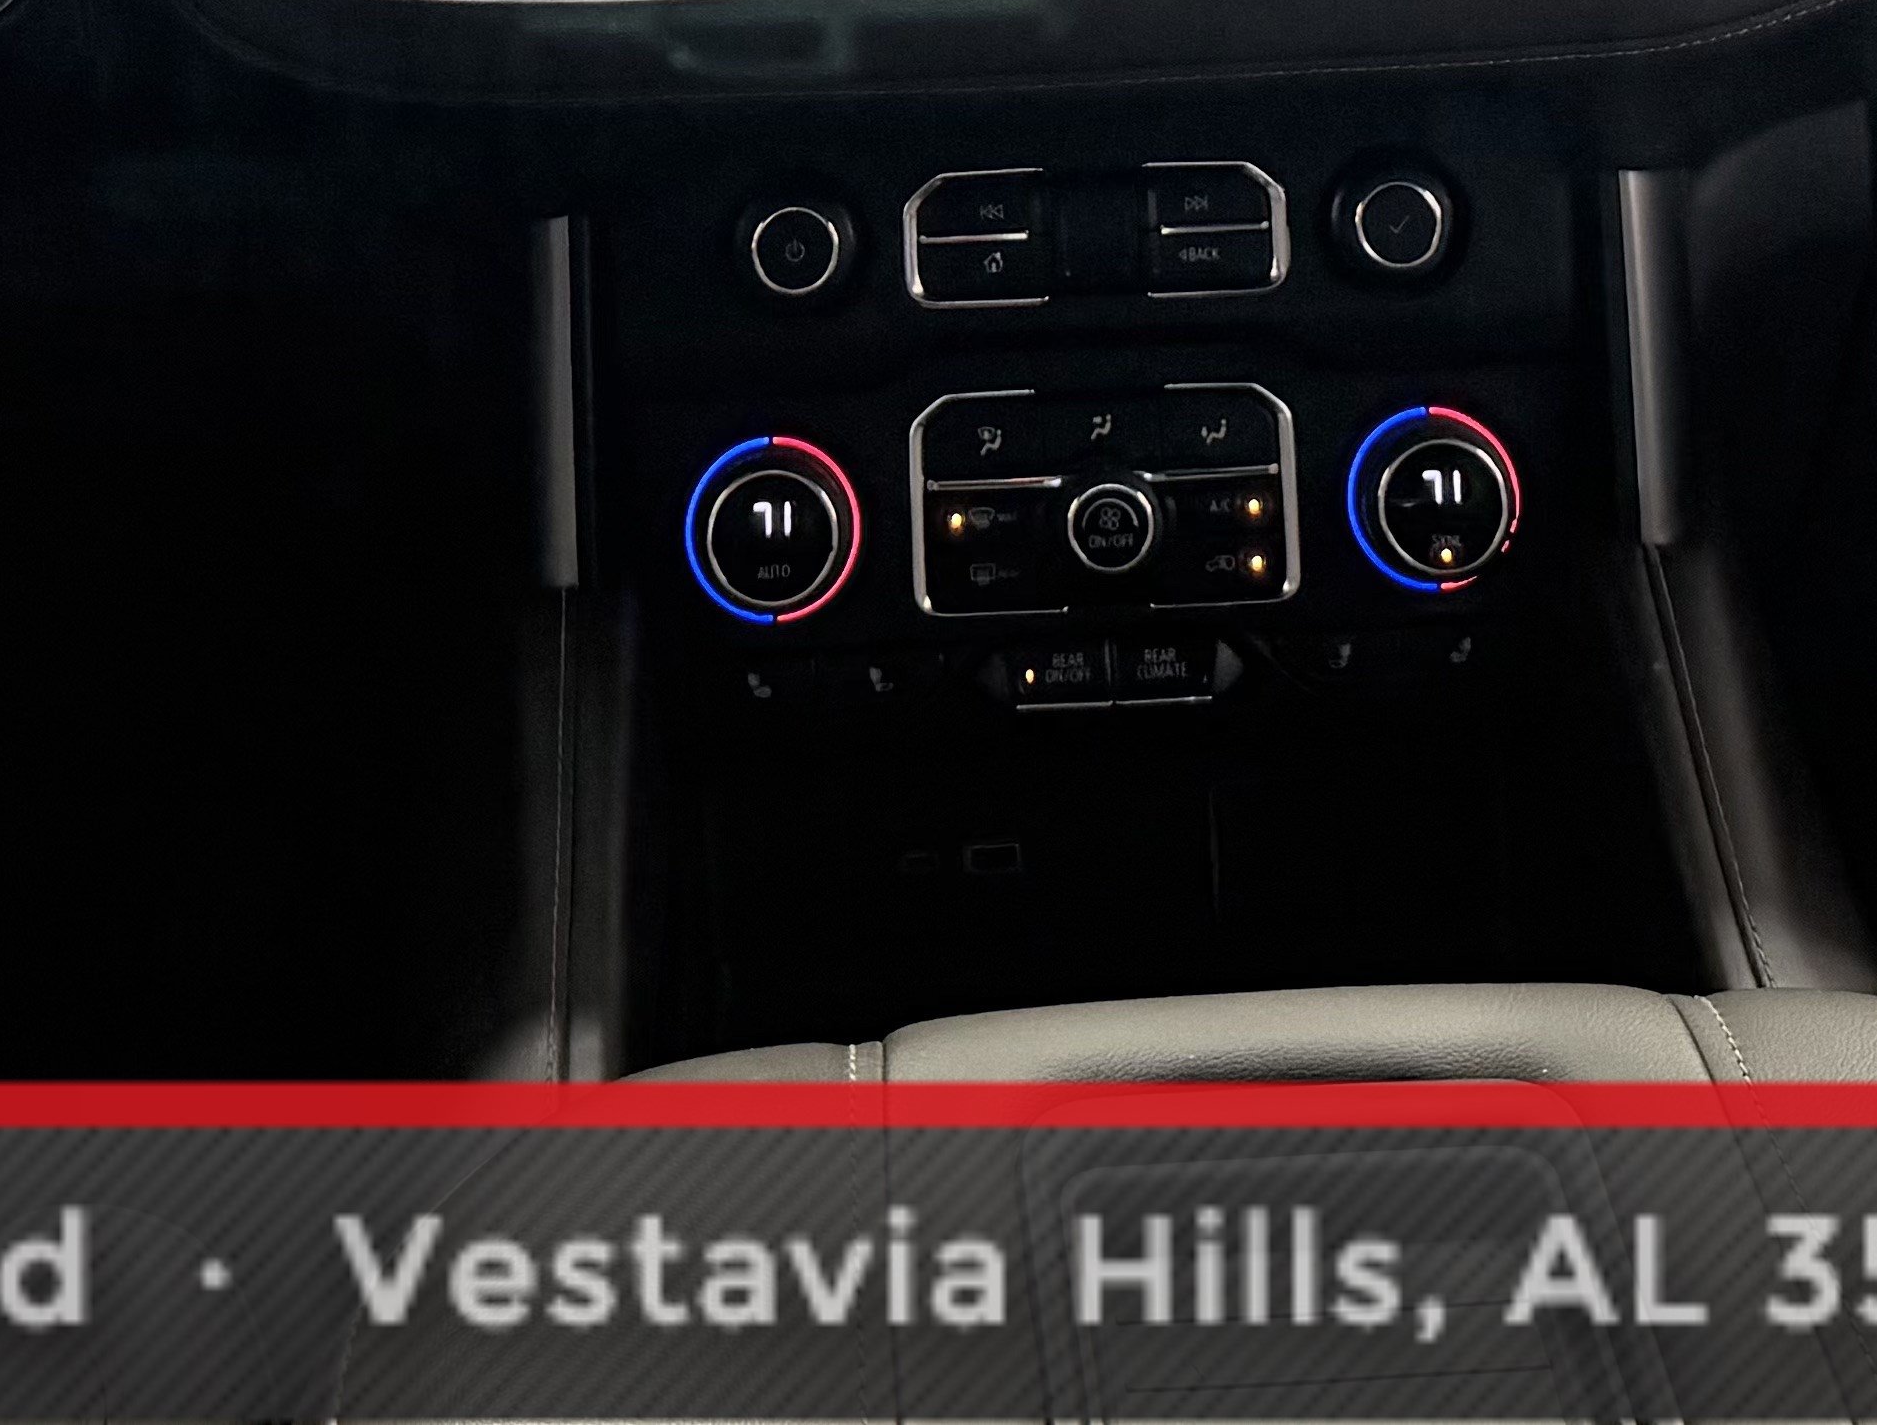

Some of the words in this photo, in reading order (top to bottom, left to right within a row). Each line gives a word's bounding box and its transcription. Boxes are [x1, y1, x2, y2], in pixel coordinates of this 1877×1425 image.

[1422, 469, 1462, 504] 71
[752, 500, 792, 539] 71
[1088, 533, 1135, 549] ON/OFF
[757, 564, 792, 580] AUTO
[1144, 647, 1177, 663] REAR
